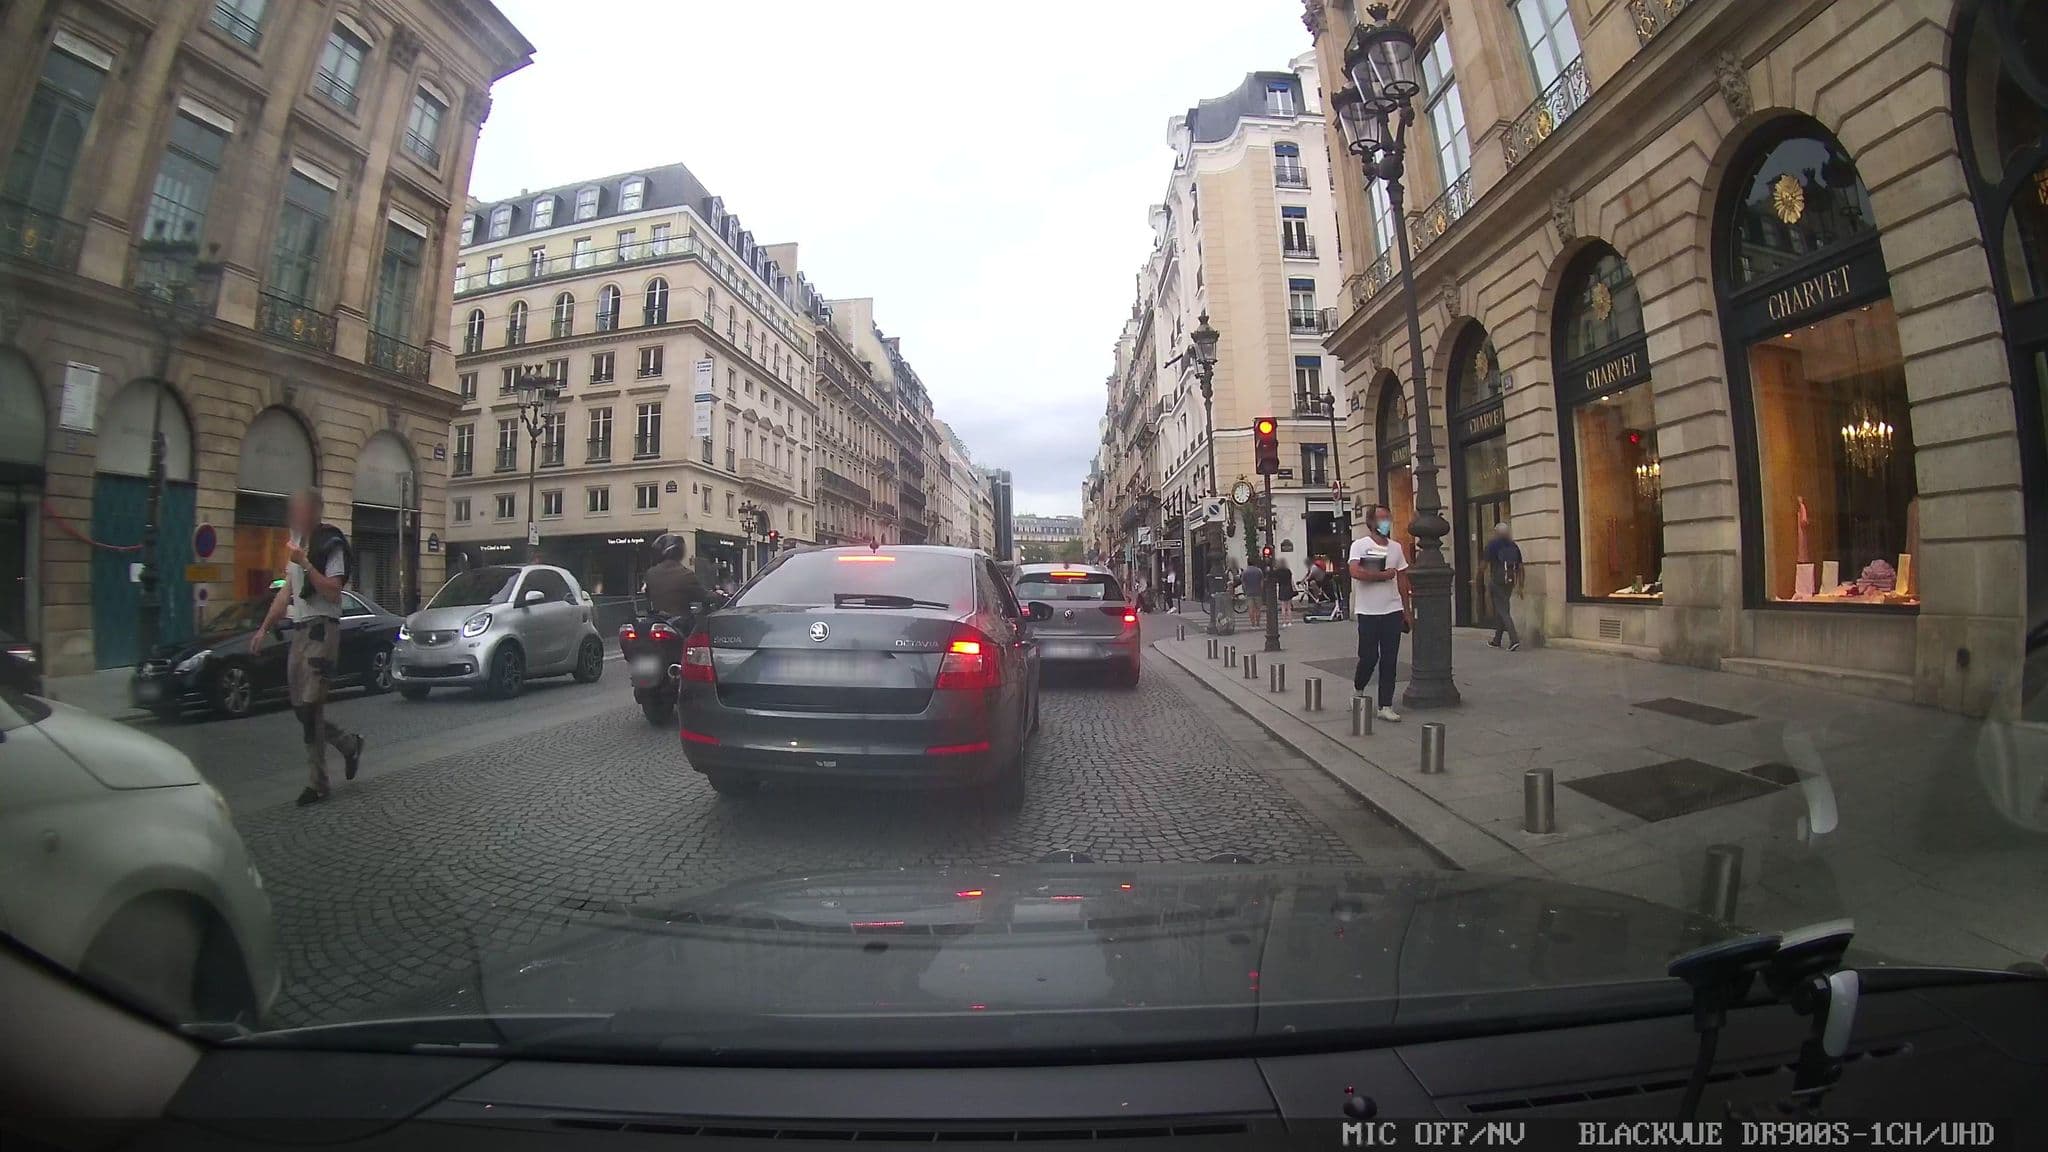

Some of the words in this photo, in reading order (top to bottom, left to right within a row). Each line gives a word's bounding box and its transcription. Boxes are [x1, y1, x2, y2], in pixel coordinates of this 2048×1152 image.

[1768, 264, 1850, 320] CHARVET
[1585, 352, 1637, 391] CHARVET
[1469, 407, 1504, 433] CHARVET
[895, 639, 939, 648] OCTAVIA
